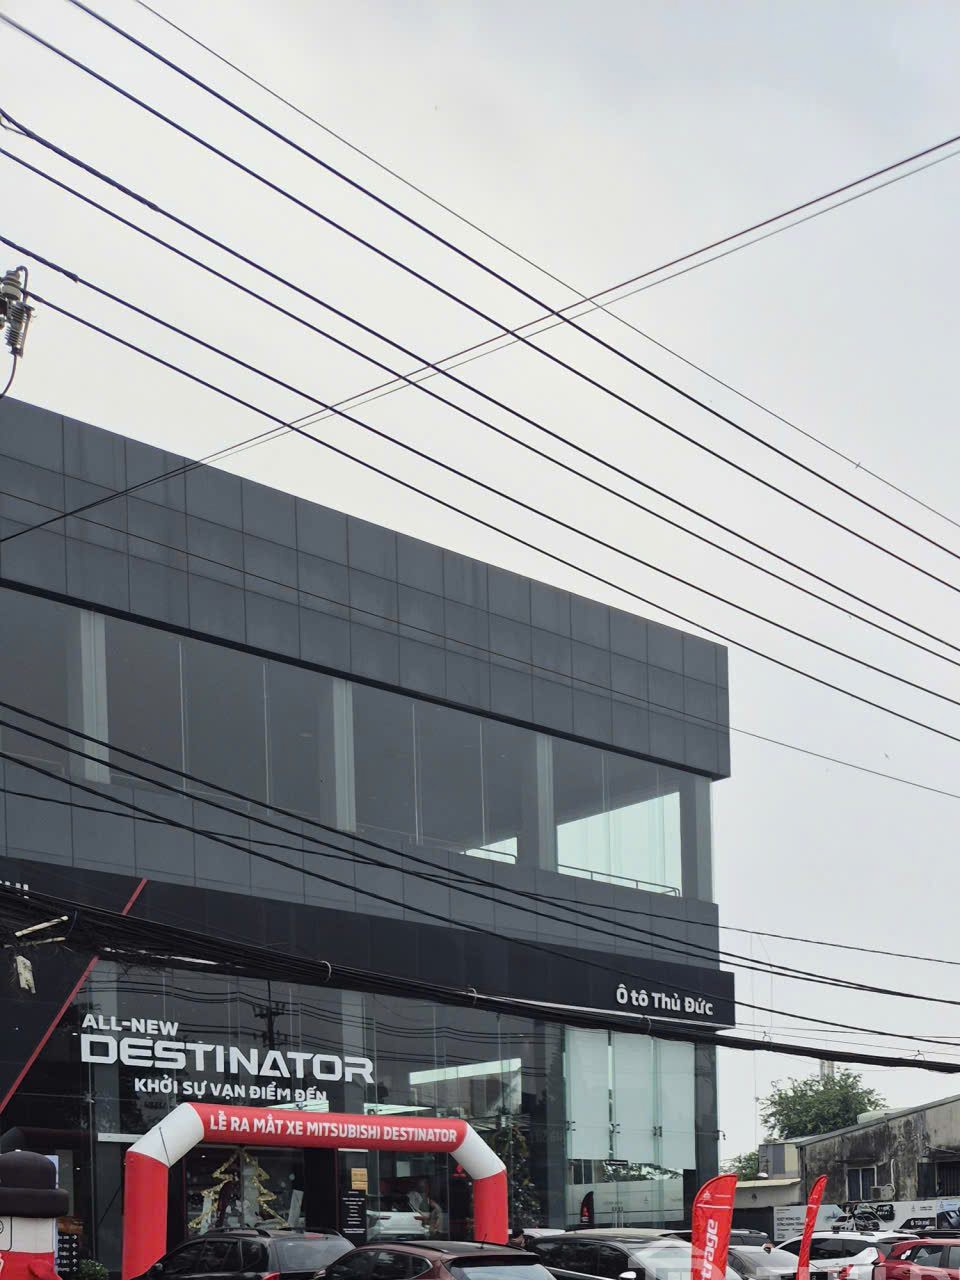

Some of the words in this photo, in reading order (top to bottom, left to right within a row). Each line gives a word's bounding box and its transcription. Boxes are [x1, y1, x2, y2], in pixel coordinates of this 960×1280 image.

[616, 984, 628, 1004] Ô
[630, 990, 648, 1007] tô
[651, 993, 681, 1011] Thủ
[684, 998, 713, 1015] Đức
[82, 1013, 178, 1036] ALL-NEW
[80, 1033, 375, 1083] DESTINATOR
[134, 1074, 178, 1094] KHỞI
[182, 1080, 207, 1099] SỰ
[210, 1083, 246, 1100] VẠN
[249, 1081, 291, 1101] ĐIỂM
[294, 1086, 327, 1102] ĐẾN
[210, 1111, 227, 1131] LỄ
[230, 1116, 250, 1133] RA
[286, 1120, 304, 1136] XE
[306, 1122, 381, 1140] MITSUBISHI
[383, 1126, 457, 1143] DESTINATOR
